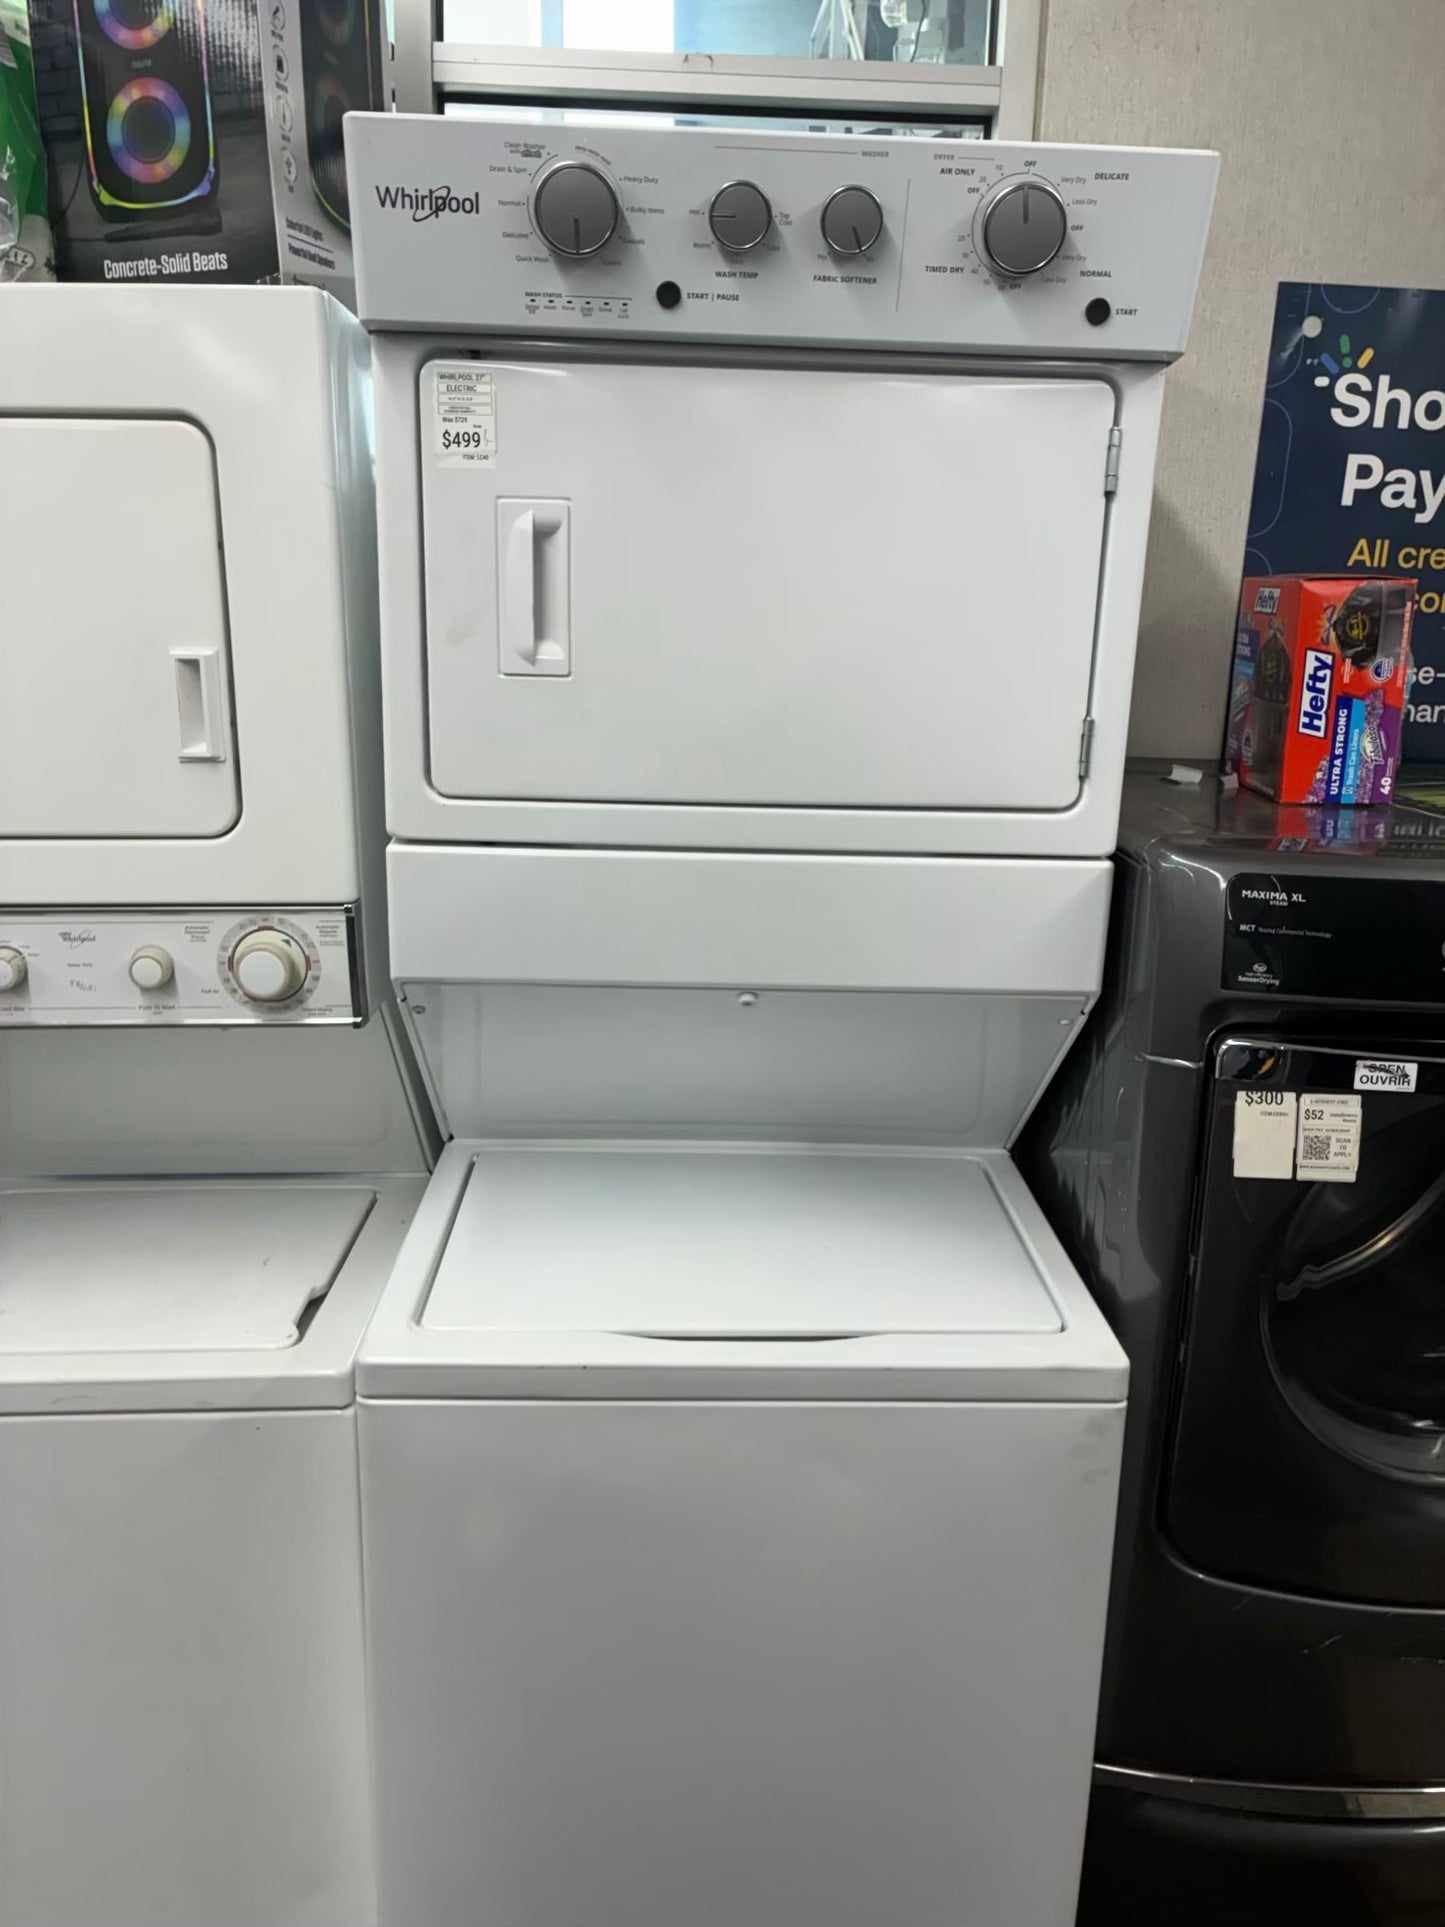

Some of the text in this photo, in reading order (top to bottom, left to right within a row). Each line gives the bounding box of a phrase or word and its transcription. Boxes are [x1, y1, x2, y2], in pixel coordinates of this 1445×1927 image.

[933, 153, 955, 161] DRYER
[1023, 160, 1038, 168] OFF
[939, 168, 976, 177] AIR ONLY
[1094, 172, 1130, 182] DELICATE
[978, 176, 987, 184] 20
[1075, 176, 1087, 185] Dry
[967, 187, 981, 195] OFF
[375, 185, 480, 220] Whirlpool
[1086, 199, 1098, 207] Dry
[1070, 224, 1084, 232] OFF
[1075, 255, 1087, 263] Dry
[103, 250, 228, 280] Concrete-Solid Beats
[925, 266, 965, 275] TIMED DRY
[1079, 270, 1113, 279] NORMAL
[715, 271, 759, 280] WASH TEMP
[813, 274, 877, 285] FABRIC SOFTENER
[687, 292, 709, 301] START
[716, 293, 740, 302] PAUSE
[1115, 308, 1138, 317] START
[439, 373, 474, 381] WHIRLPOOL
[446, 384, 478, 393] ELECTRIC
[1330, 372, 1445, 432] Sho
[442, 416, 454, 424] Was
[442, 428, 481, 450] $499
[1340, 453, 1445, 525] Pay
[1347, 538, 1390, 568] All
[1255, 589, 1279, 613] Hefty
[1301, 654, 1333, 735] Hefty
[1330, 708, 1348, 795] ULTRA STRONG
[1380, 776, 1392, 795] 40
[1241, 889, 1307, 903] MAXIMA XL
[1239, 923, 1256, 932] MCT
[1359, 1074, 1411, 1087] OUVRIR
[1244, 1091, 1284, 1107] $300
[1304, 1108, 1324, 1121] $52
